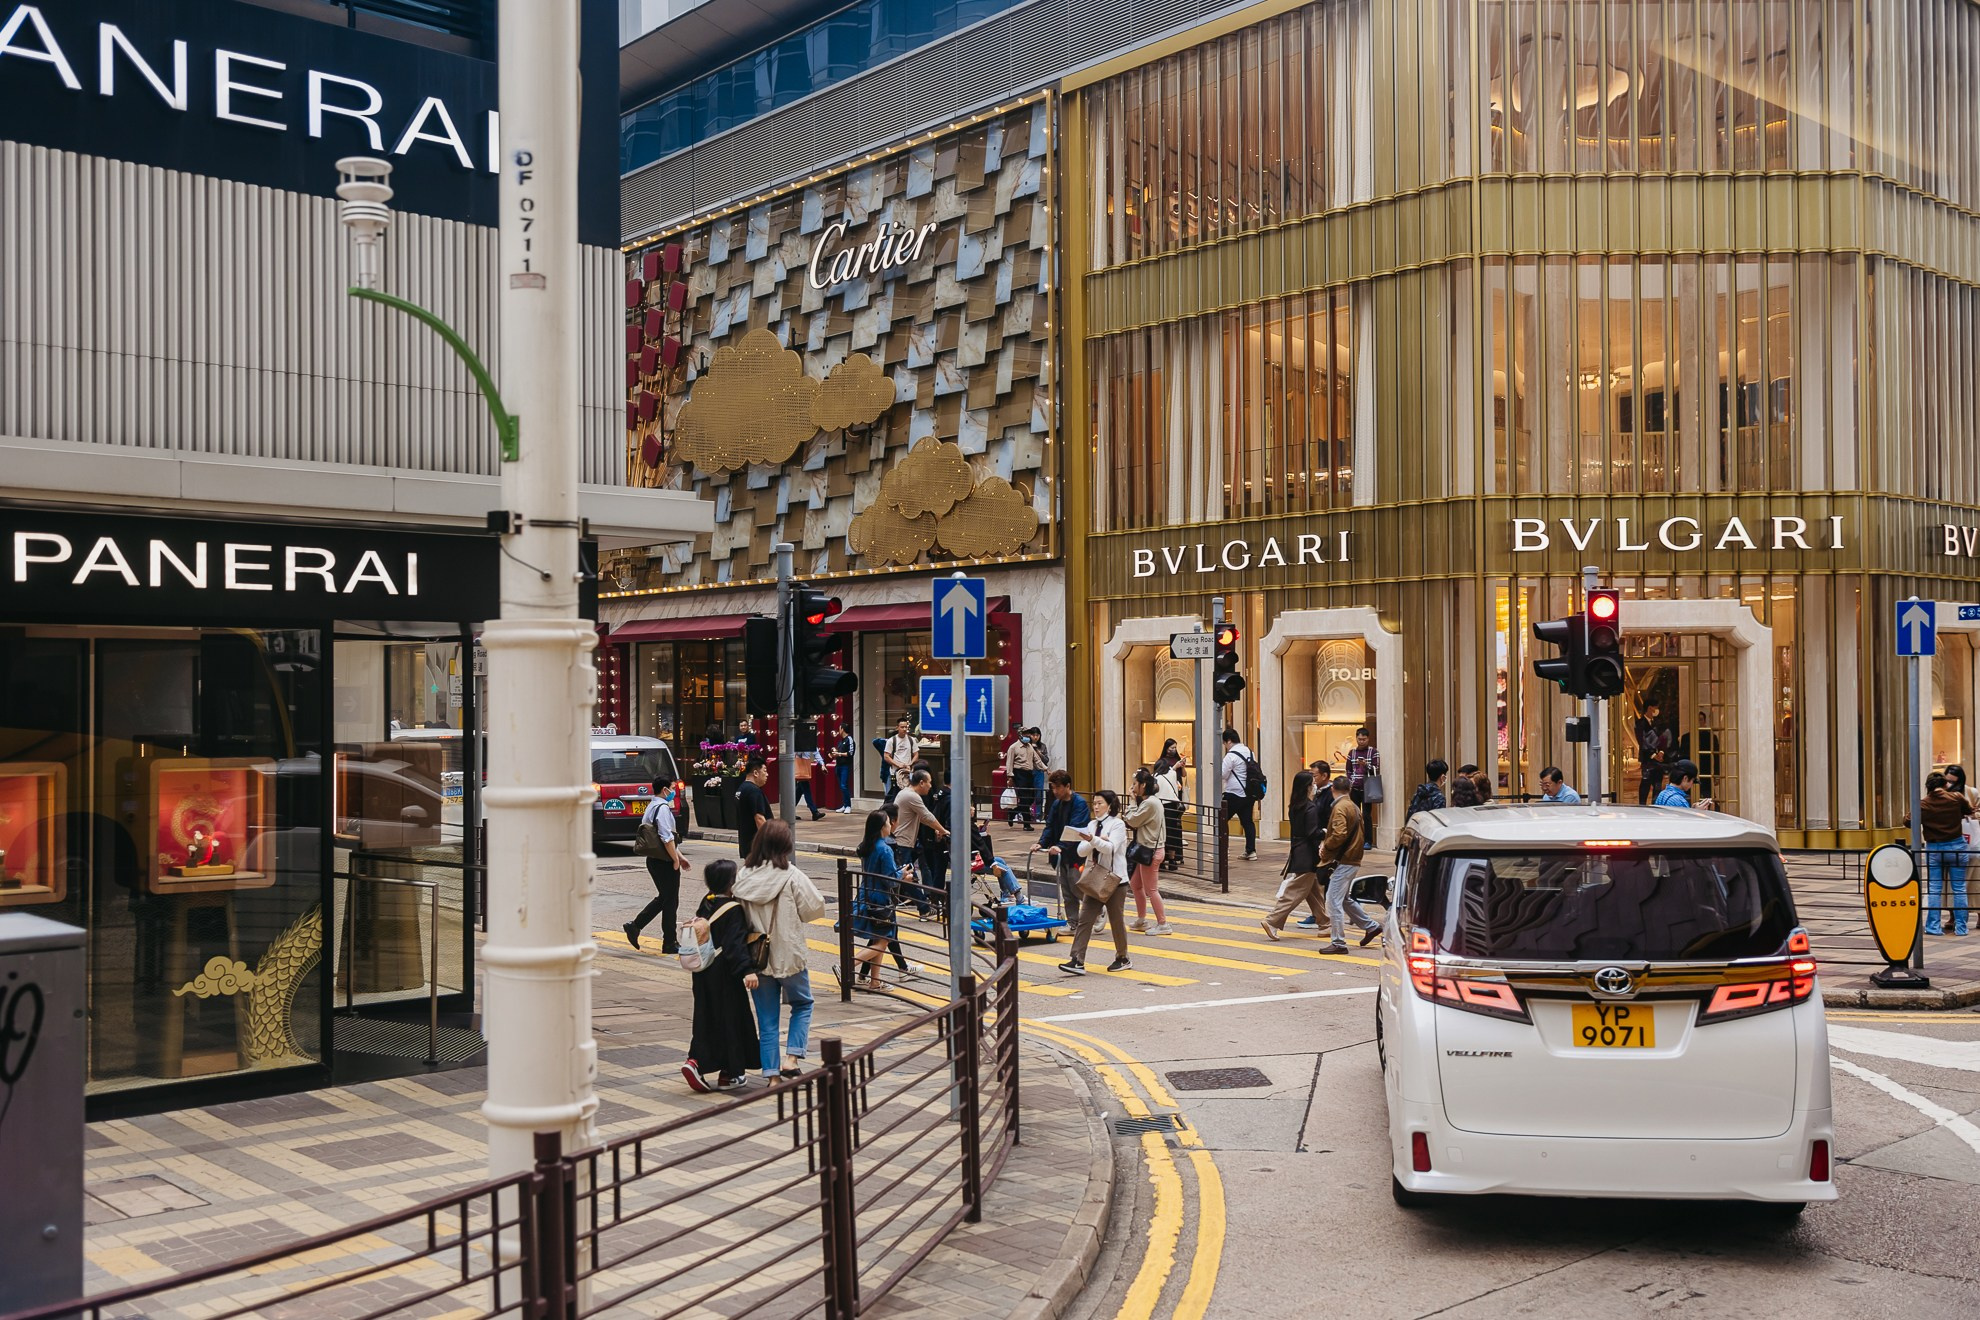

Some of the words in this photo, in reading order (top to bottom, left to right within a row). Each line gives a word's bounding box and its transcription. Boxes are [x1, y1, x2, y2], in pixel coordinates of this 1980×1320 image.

[520, 198, 535, 273] 0711
[809, 220, 938, 290] Cartier
[1512, 515, 1845, 552] BVLGARI
[1943, 523, 1979, 558] BV
[13, 531, 419, 596] PANERAI
[1132, 530, 1351, 578] BVLGARI
[1180, 636, 1199, 644] Peking
[1186, 646, 1209, 655] 北京道
[1871, 900, 1916, 908] 60556
[1594, 1005, 1631, 1027] YP
[1581, 1025, 1645, 1047] 9071
[1446, 1049, 1513, 1058] VELLFIRE
